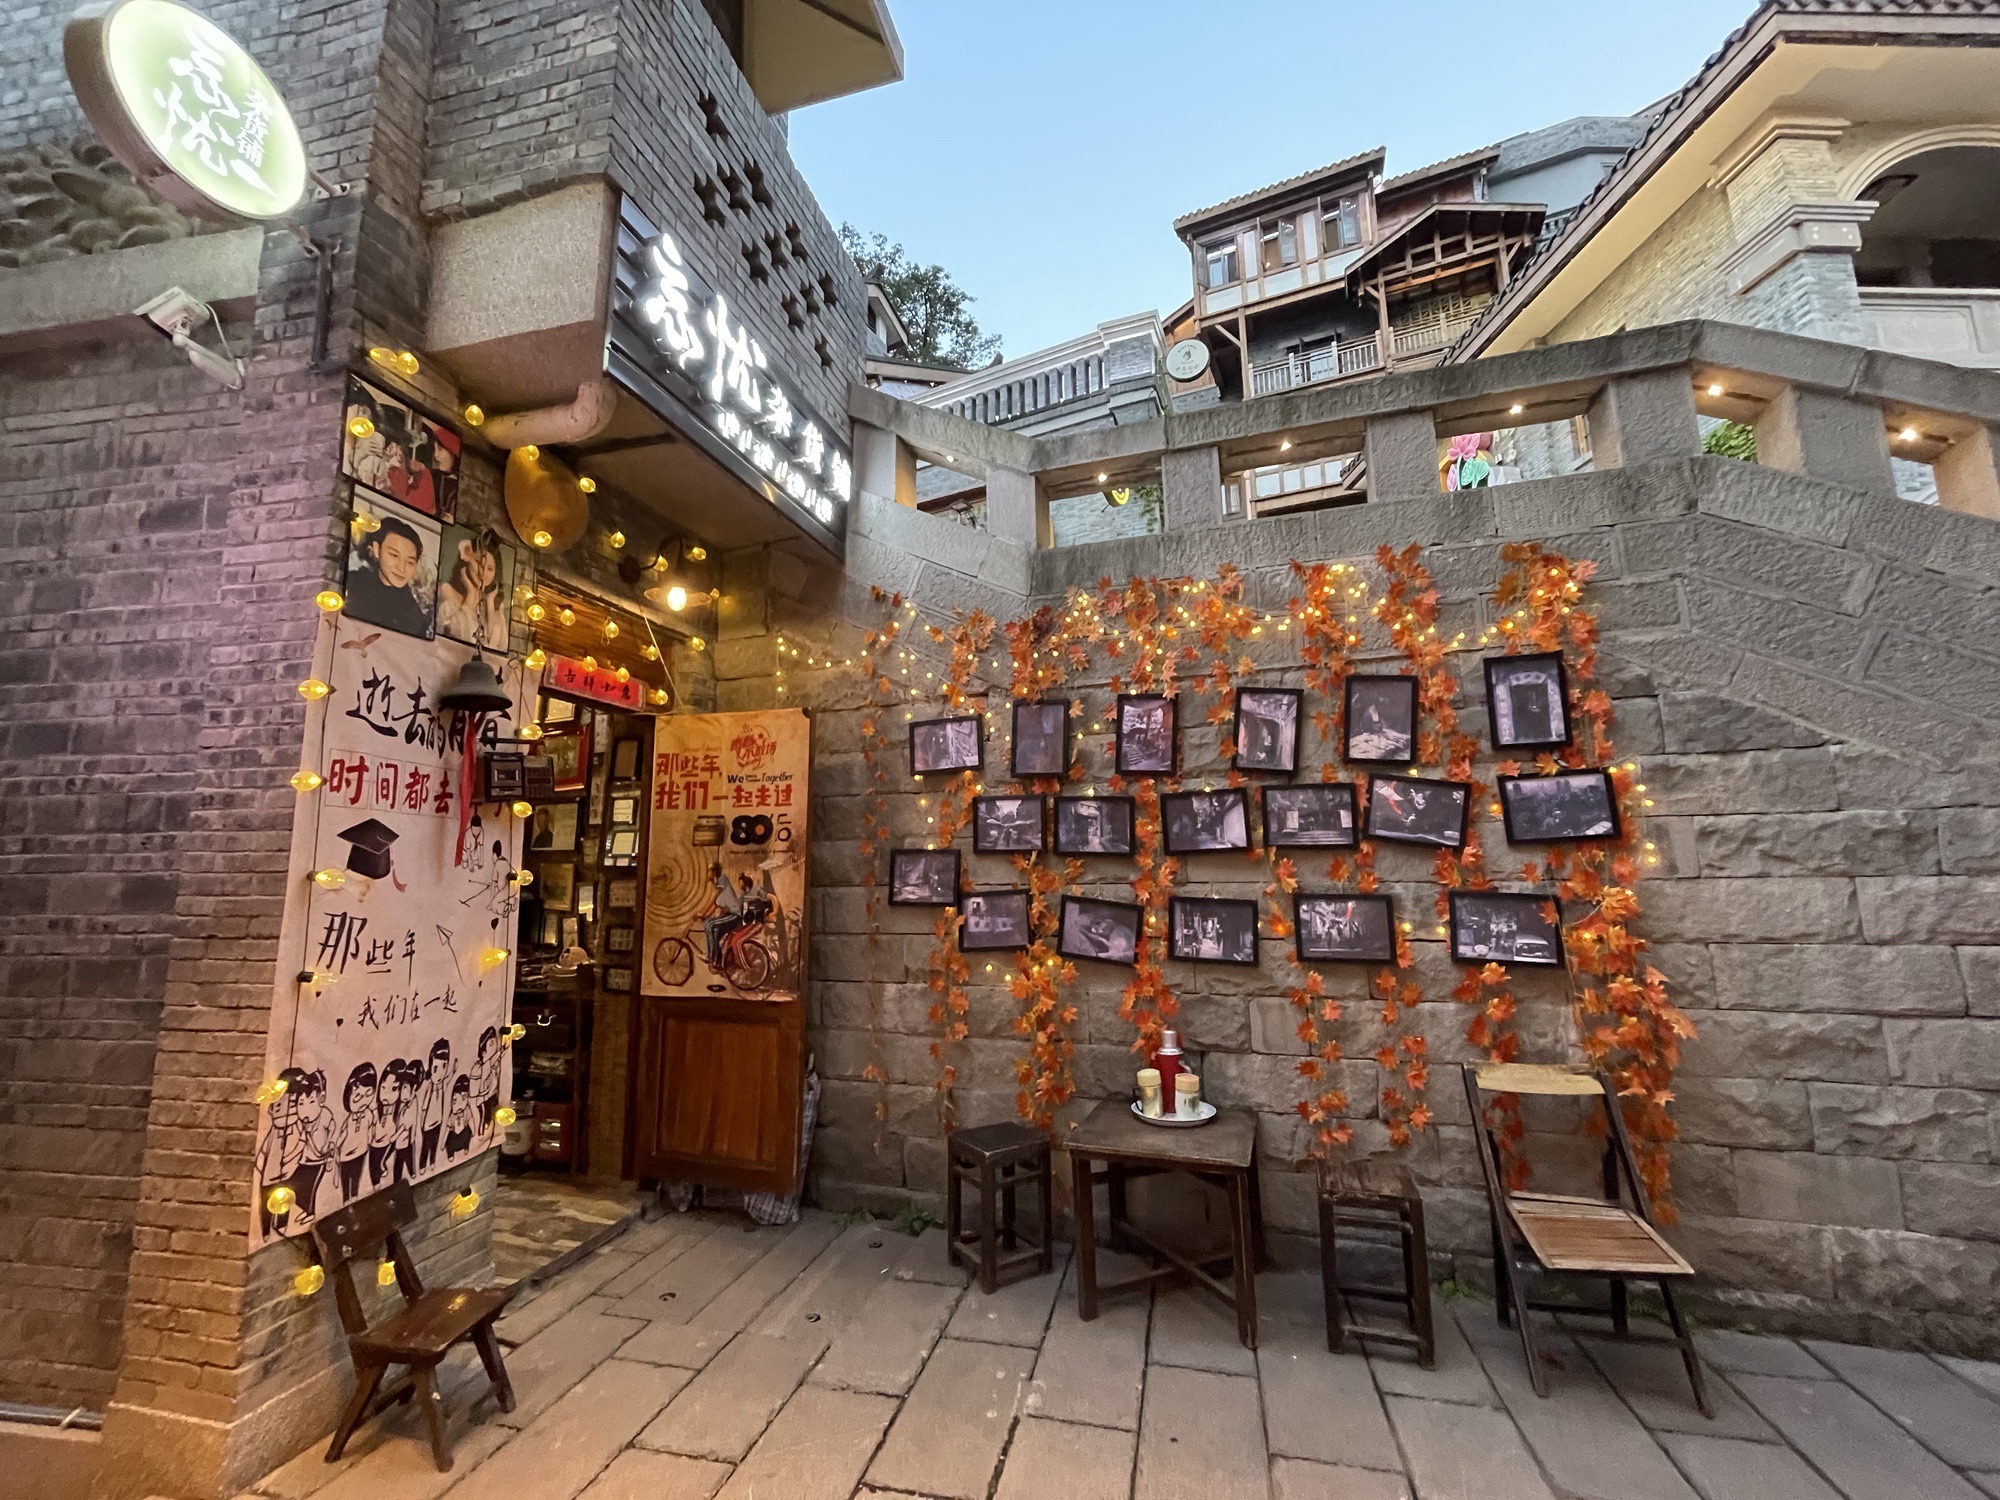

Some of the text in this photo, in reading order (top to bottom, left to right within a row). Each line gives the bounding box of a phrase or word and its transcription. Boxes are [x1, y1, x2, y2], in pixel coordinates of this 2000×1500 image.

[564, 668, 631, 700] 吉祥如意
[655, 780, 793, 810] 我们一起走过
[727, 774, 744, 784] We
[316, 911, 417, 986] 那些年
[357, 984, 458, 1030] 我们在一起
